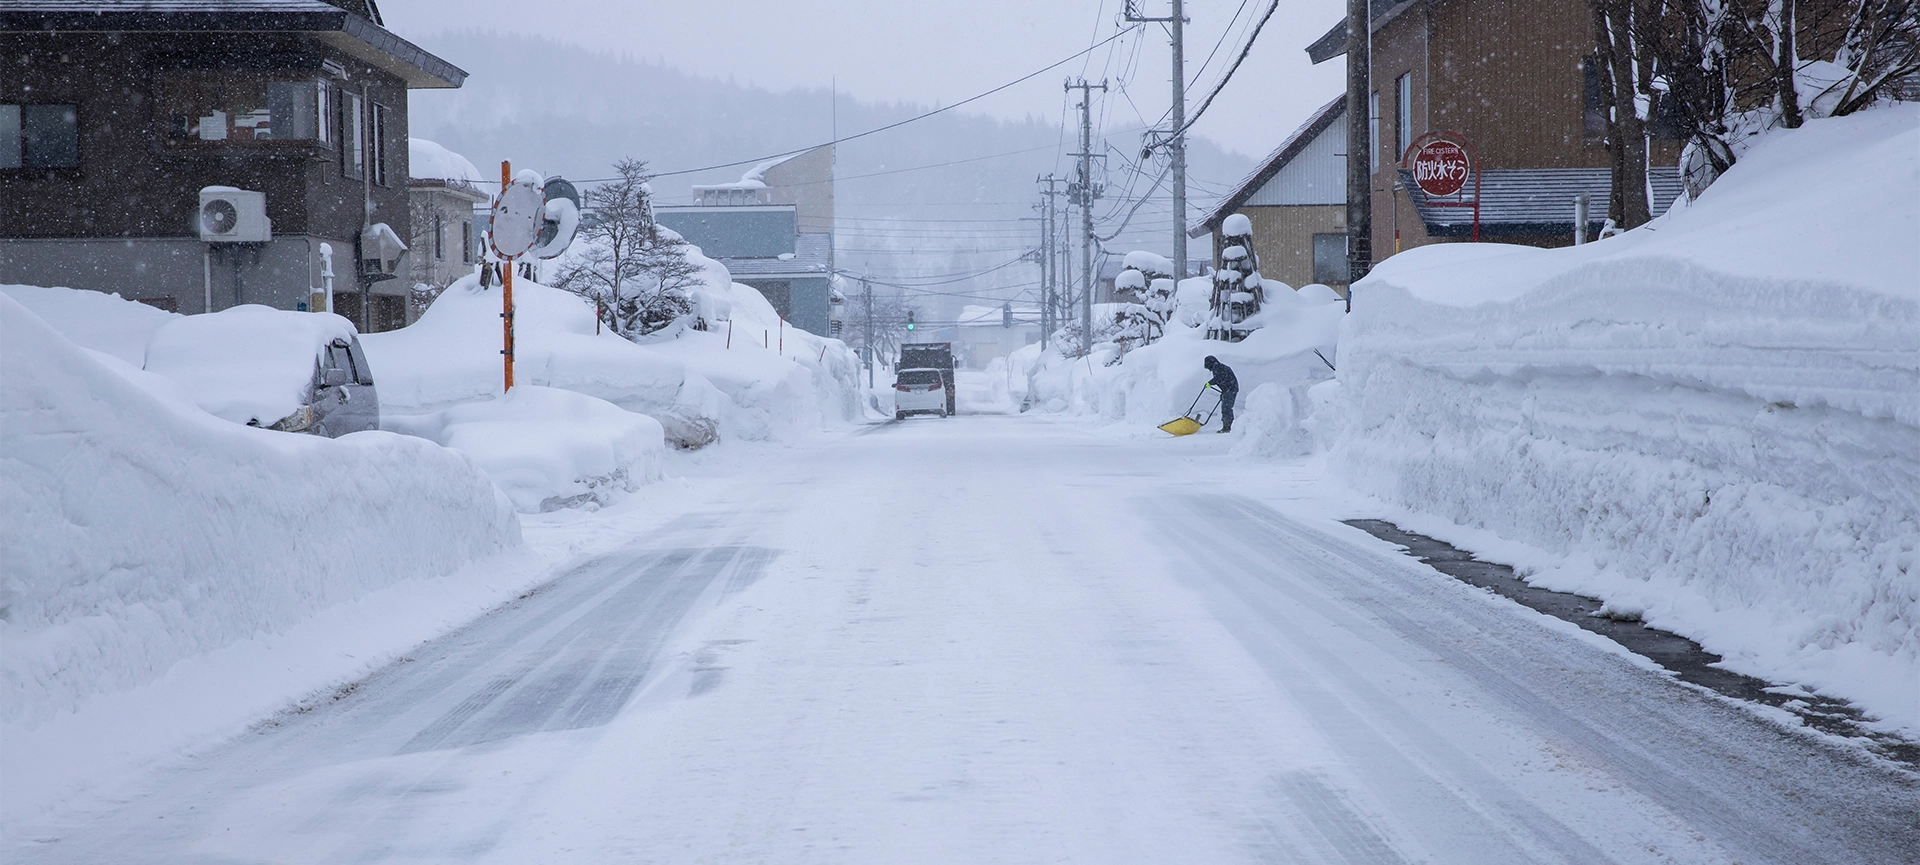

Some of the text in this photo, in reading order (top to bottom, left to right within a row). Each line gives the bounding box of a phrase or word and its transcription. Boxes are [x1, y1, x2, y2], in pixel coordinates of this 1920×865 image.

[1417, 160, 1466, 180] 防火水そう
